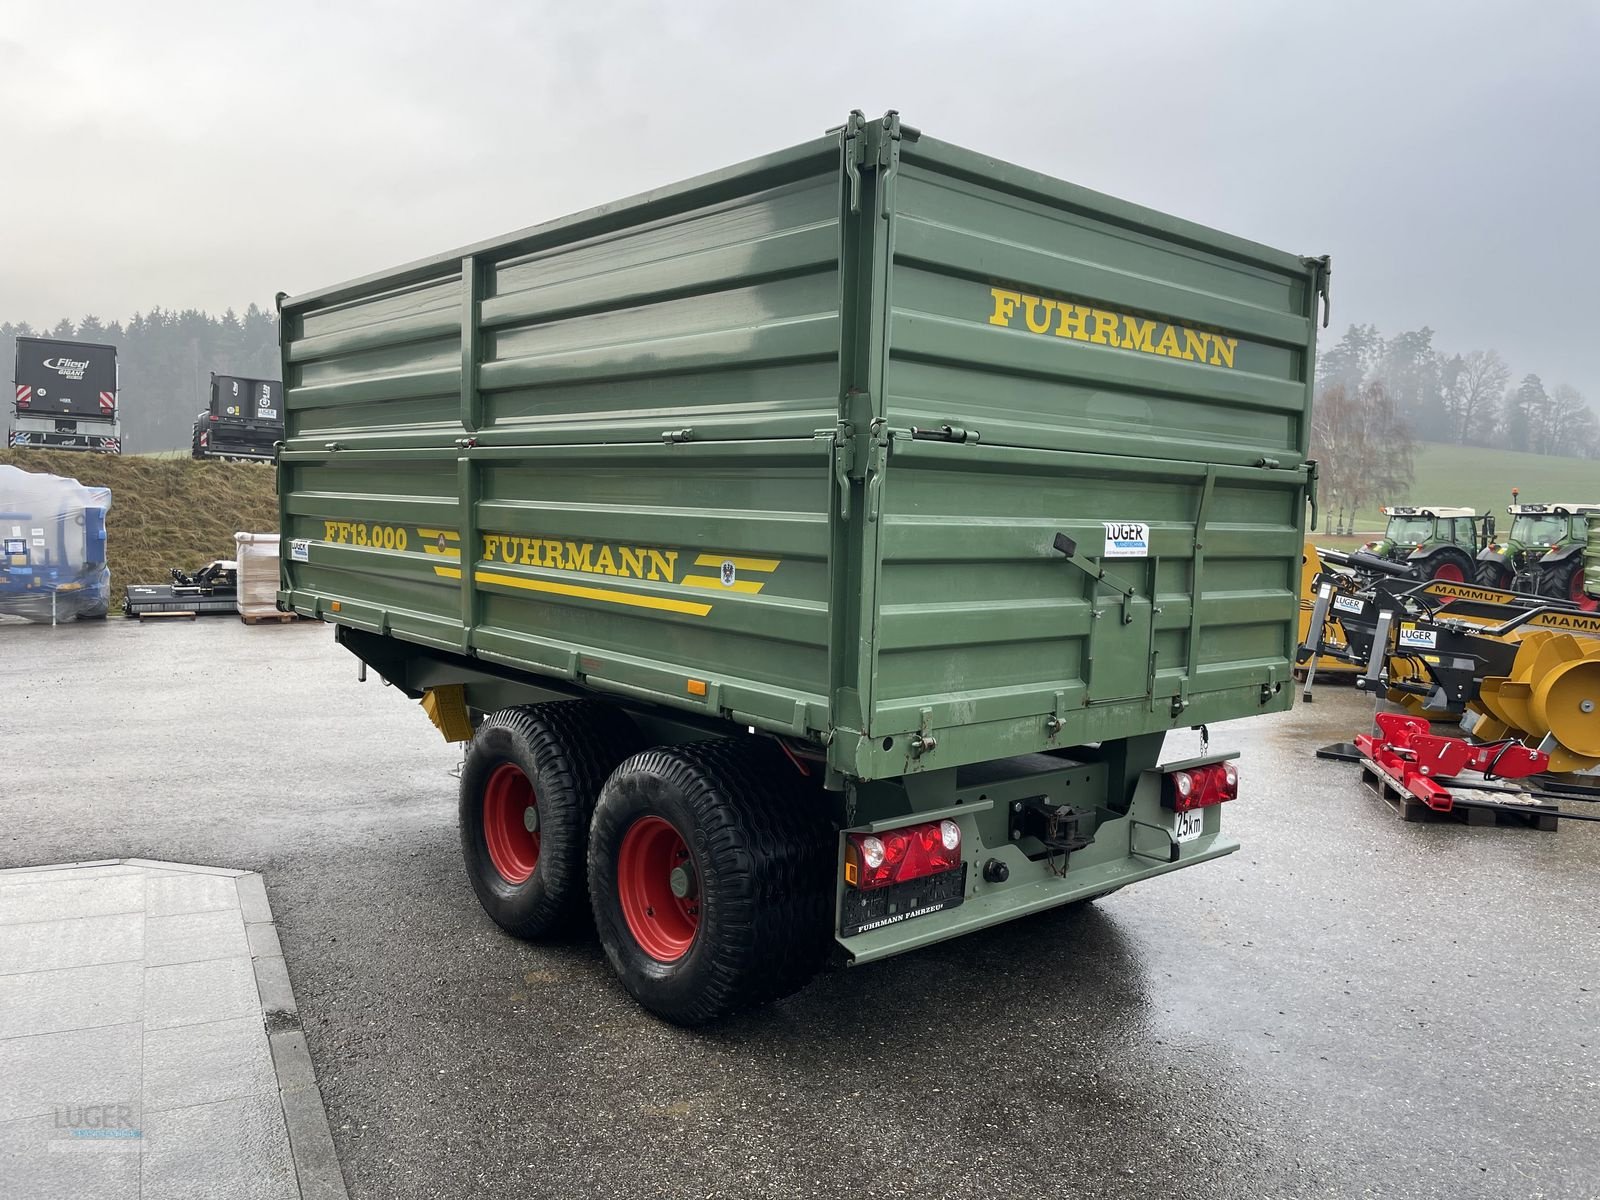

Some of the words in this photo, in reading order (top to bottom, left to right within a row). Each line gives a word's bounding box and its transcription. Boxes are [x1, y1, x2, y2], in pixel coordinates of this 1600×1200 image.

[990, 288, 1237, 368] FUHRMANN
[57, 358, 89, 370] Fliegl
[324, 521, 407, 552] FF13.000
[1106, 524, 1144, 541] LUGER
[482, 534, 678, 582] FUHRMANN
[1335, 595, 1360, 608] LUGER
[1434, 585, 1504, 602] MAMMUT
[1401, 629, 1432, 640] LUGER
[1176, 810, 1201, 838] 25km
[858, 914, 904, 933] FUHRMANN
[905, 903, 944, 919] FAHRZEU
